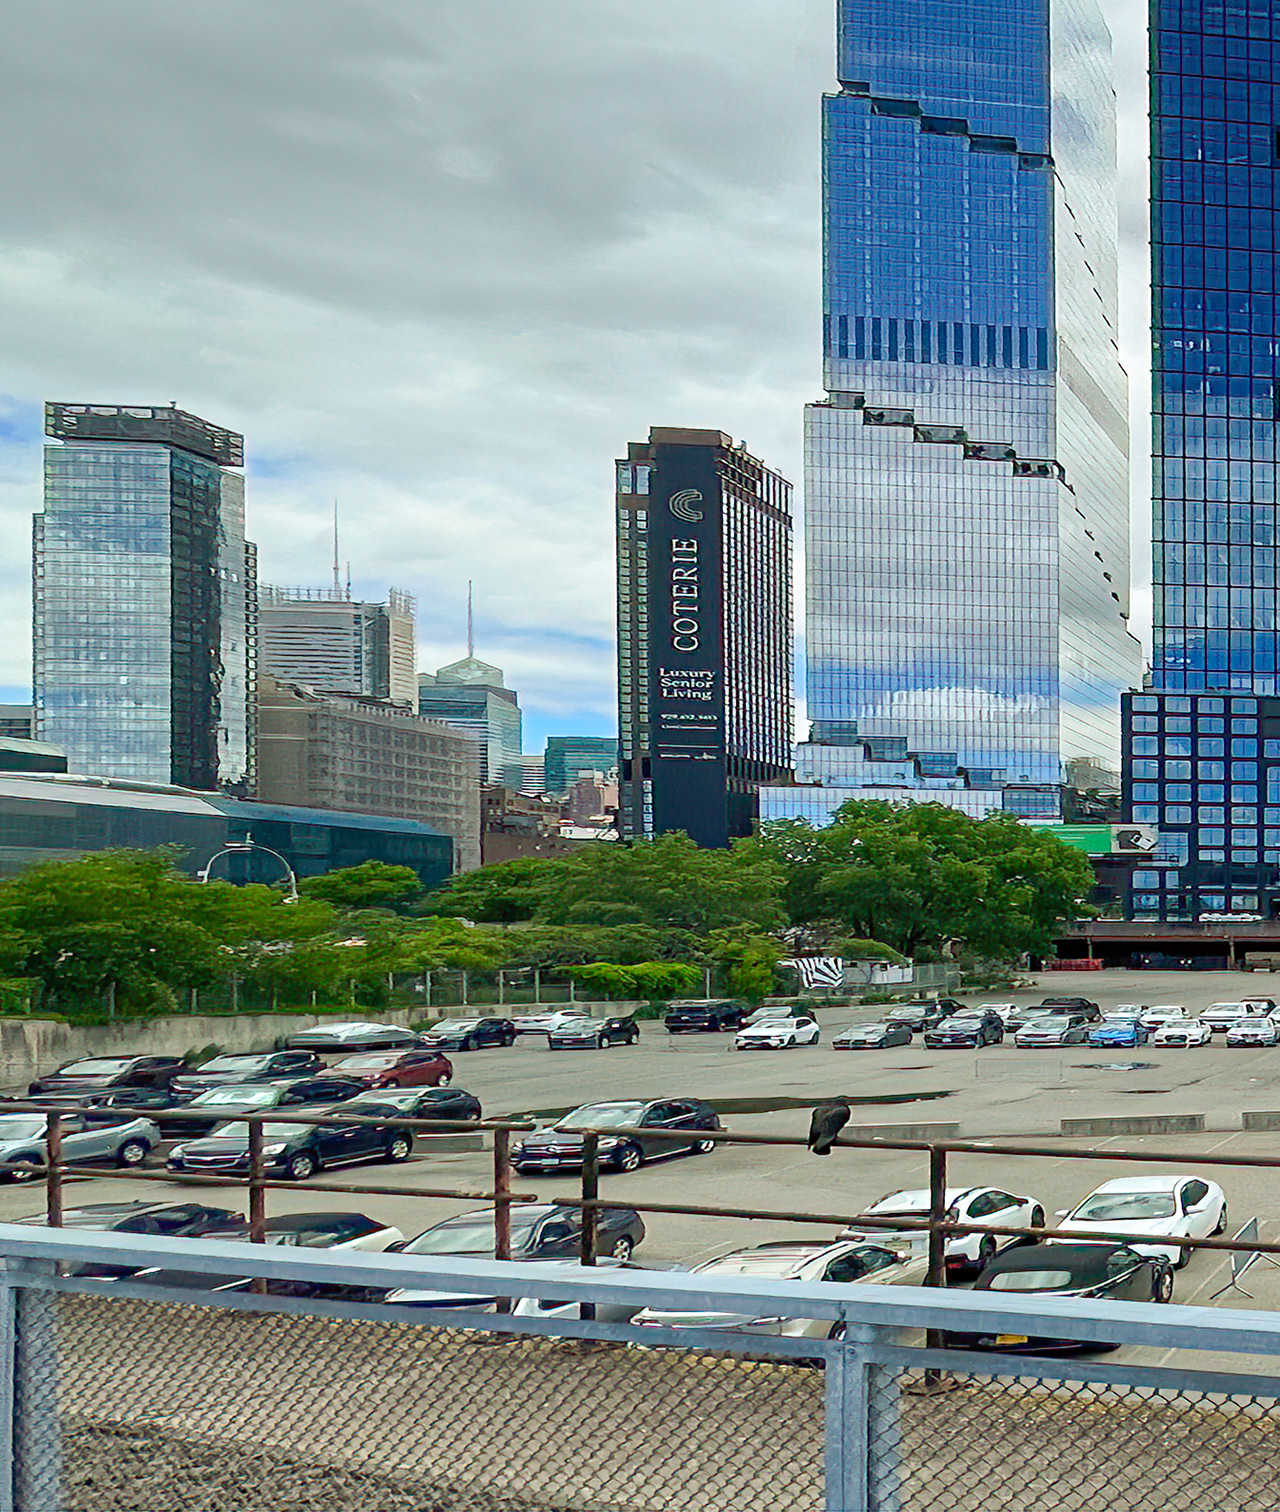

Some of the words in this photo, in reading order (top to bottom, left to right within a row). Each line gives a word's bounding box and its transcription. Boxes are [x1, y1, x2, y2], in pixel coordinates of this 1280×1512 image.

[671, 538, 699, 652] COTERIE
[659, 667, 717, 680] Luxury
[660, 678, 714, 688] Senior
[662, 688, 713, 701] Living
